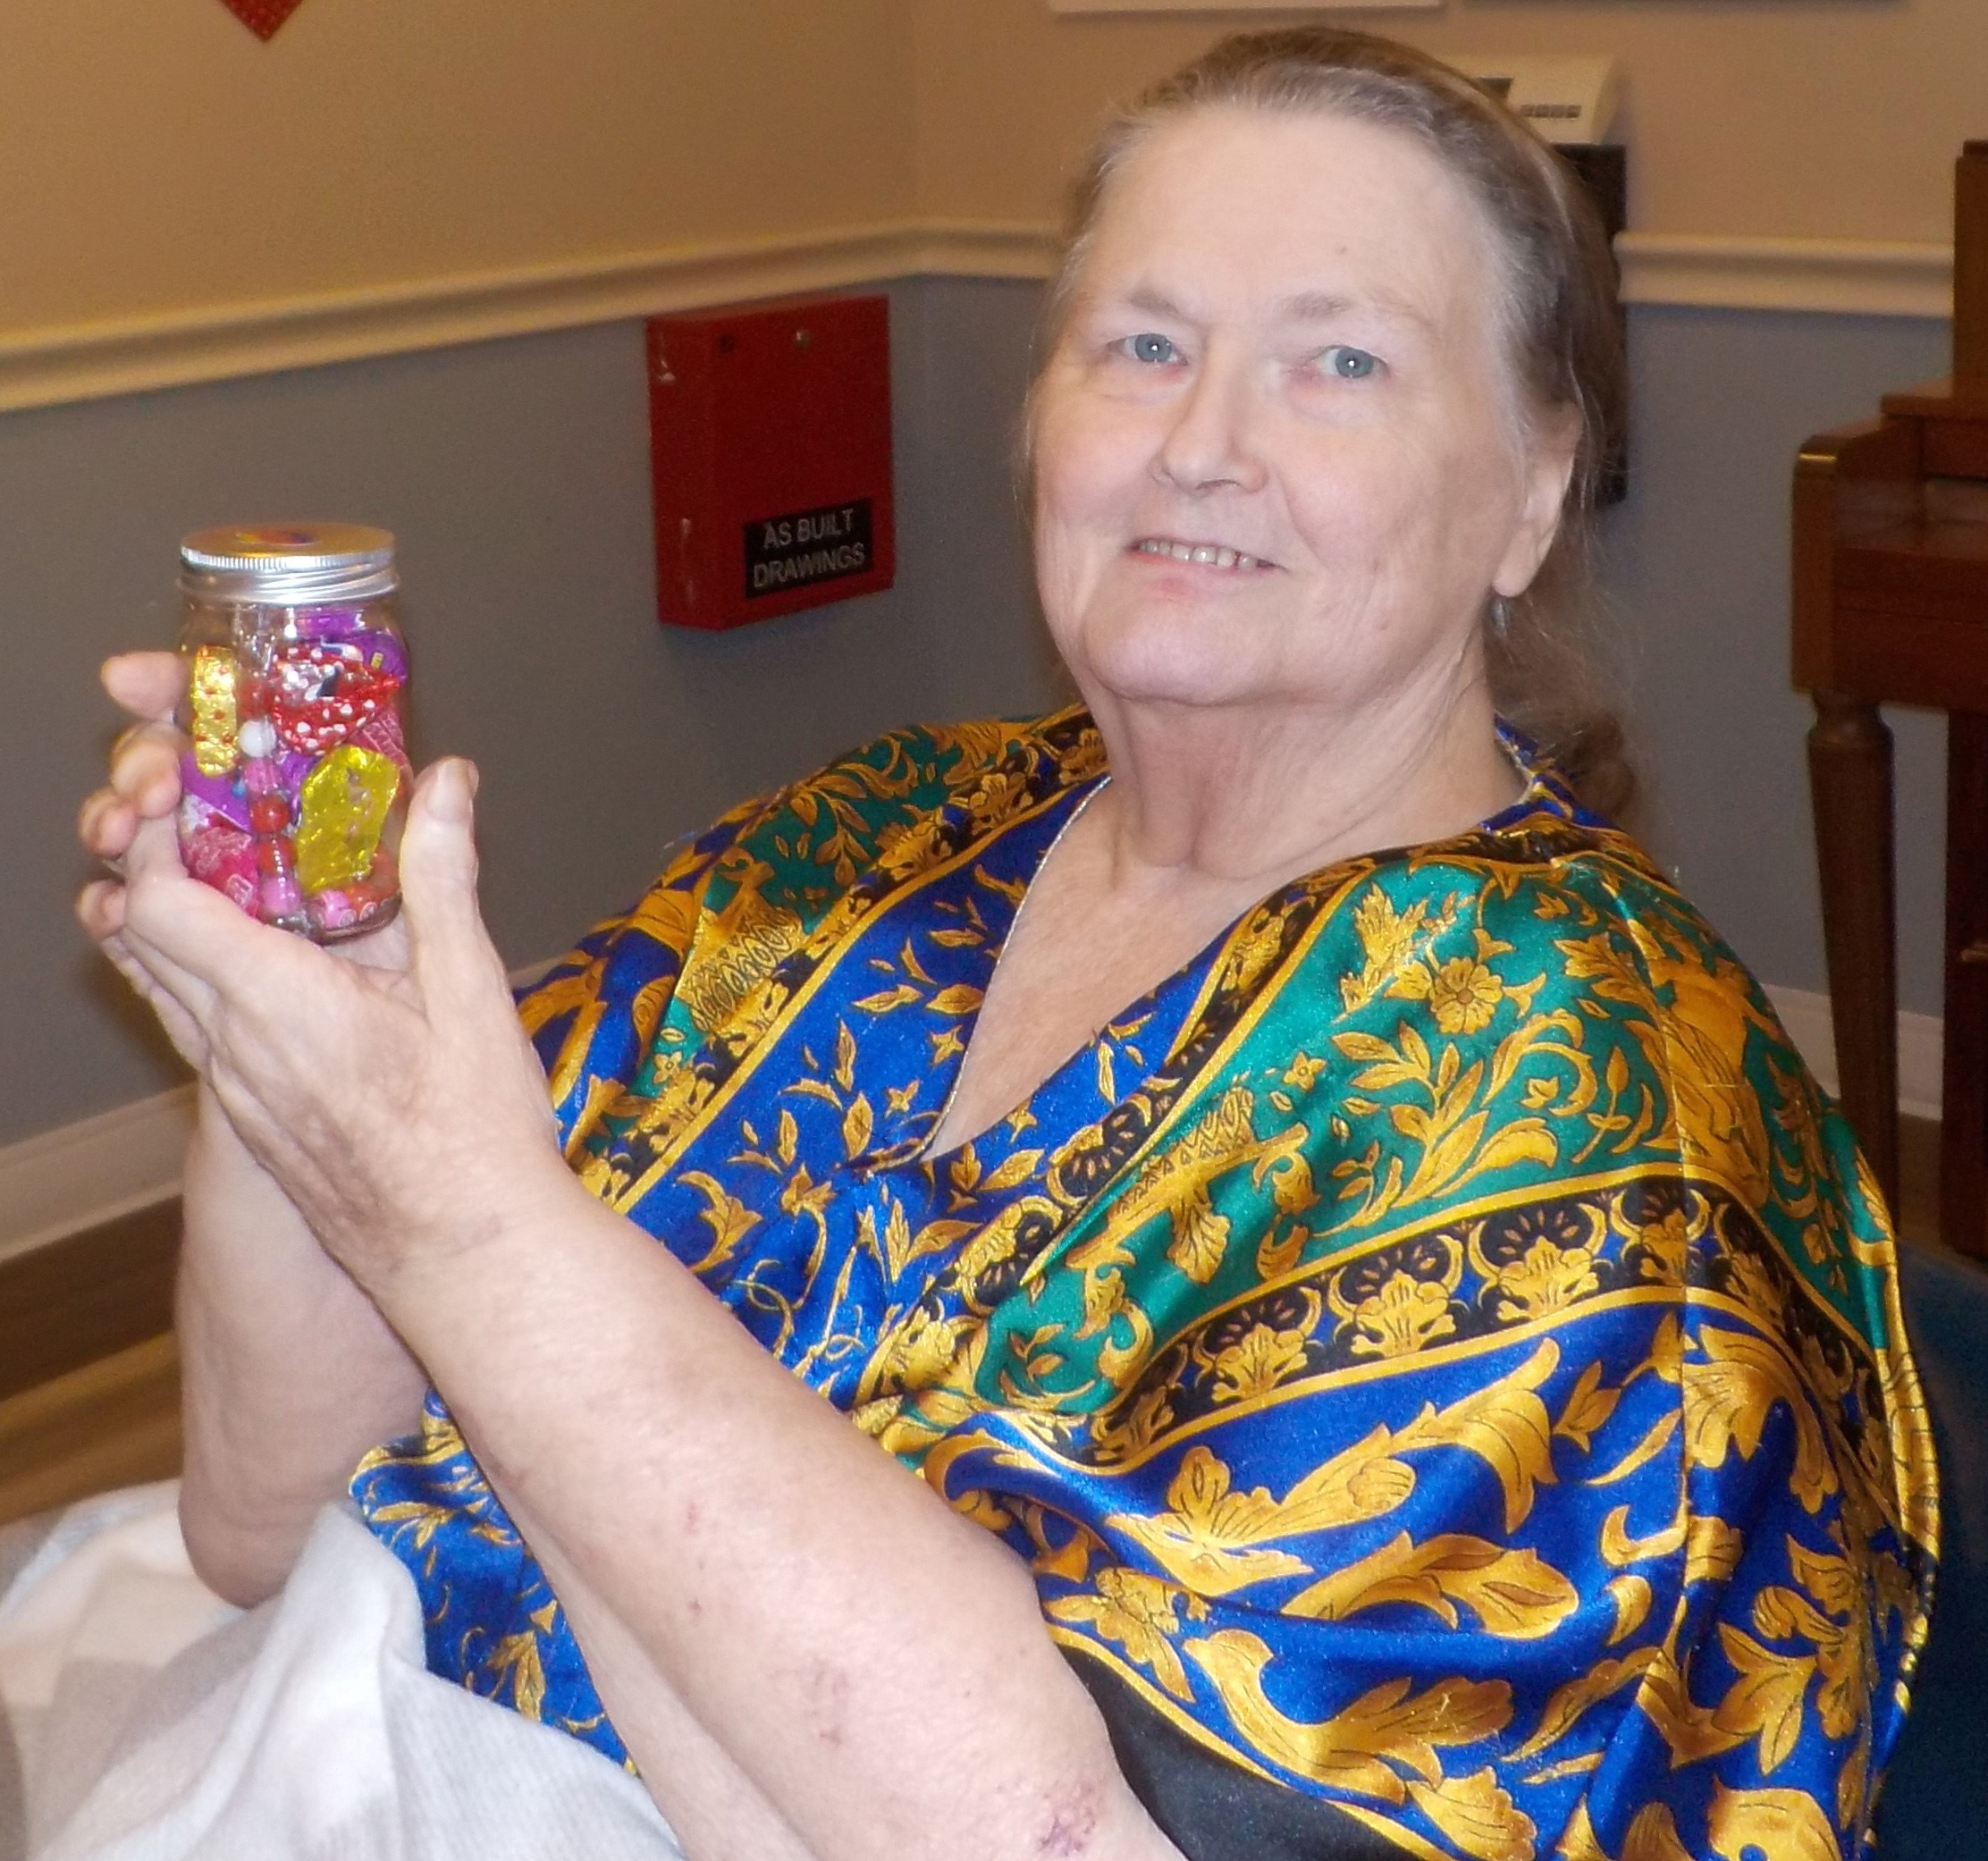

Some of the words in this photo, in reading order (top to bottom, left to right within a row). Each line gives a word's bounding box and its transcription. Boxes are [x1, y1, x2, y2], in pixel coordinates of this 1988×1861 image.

[763, 521, 793, 550] AS
[797, 509, 854, 542] BUILT
[754, 542, 865, 587] DRAWINGS
